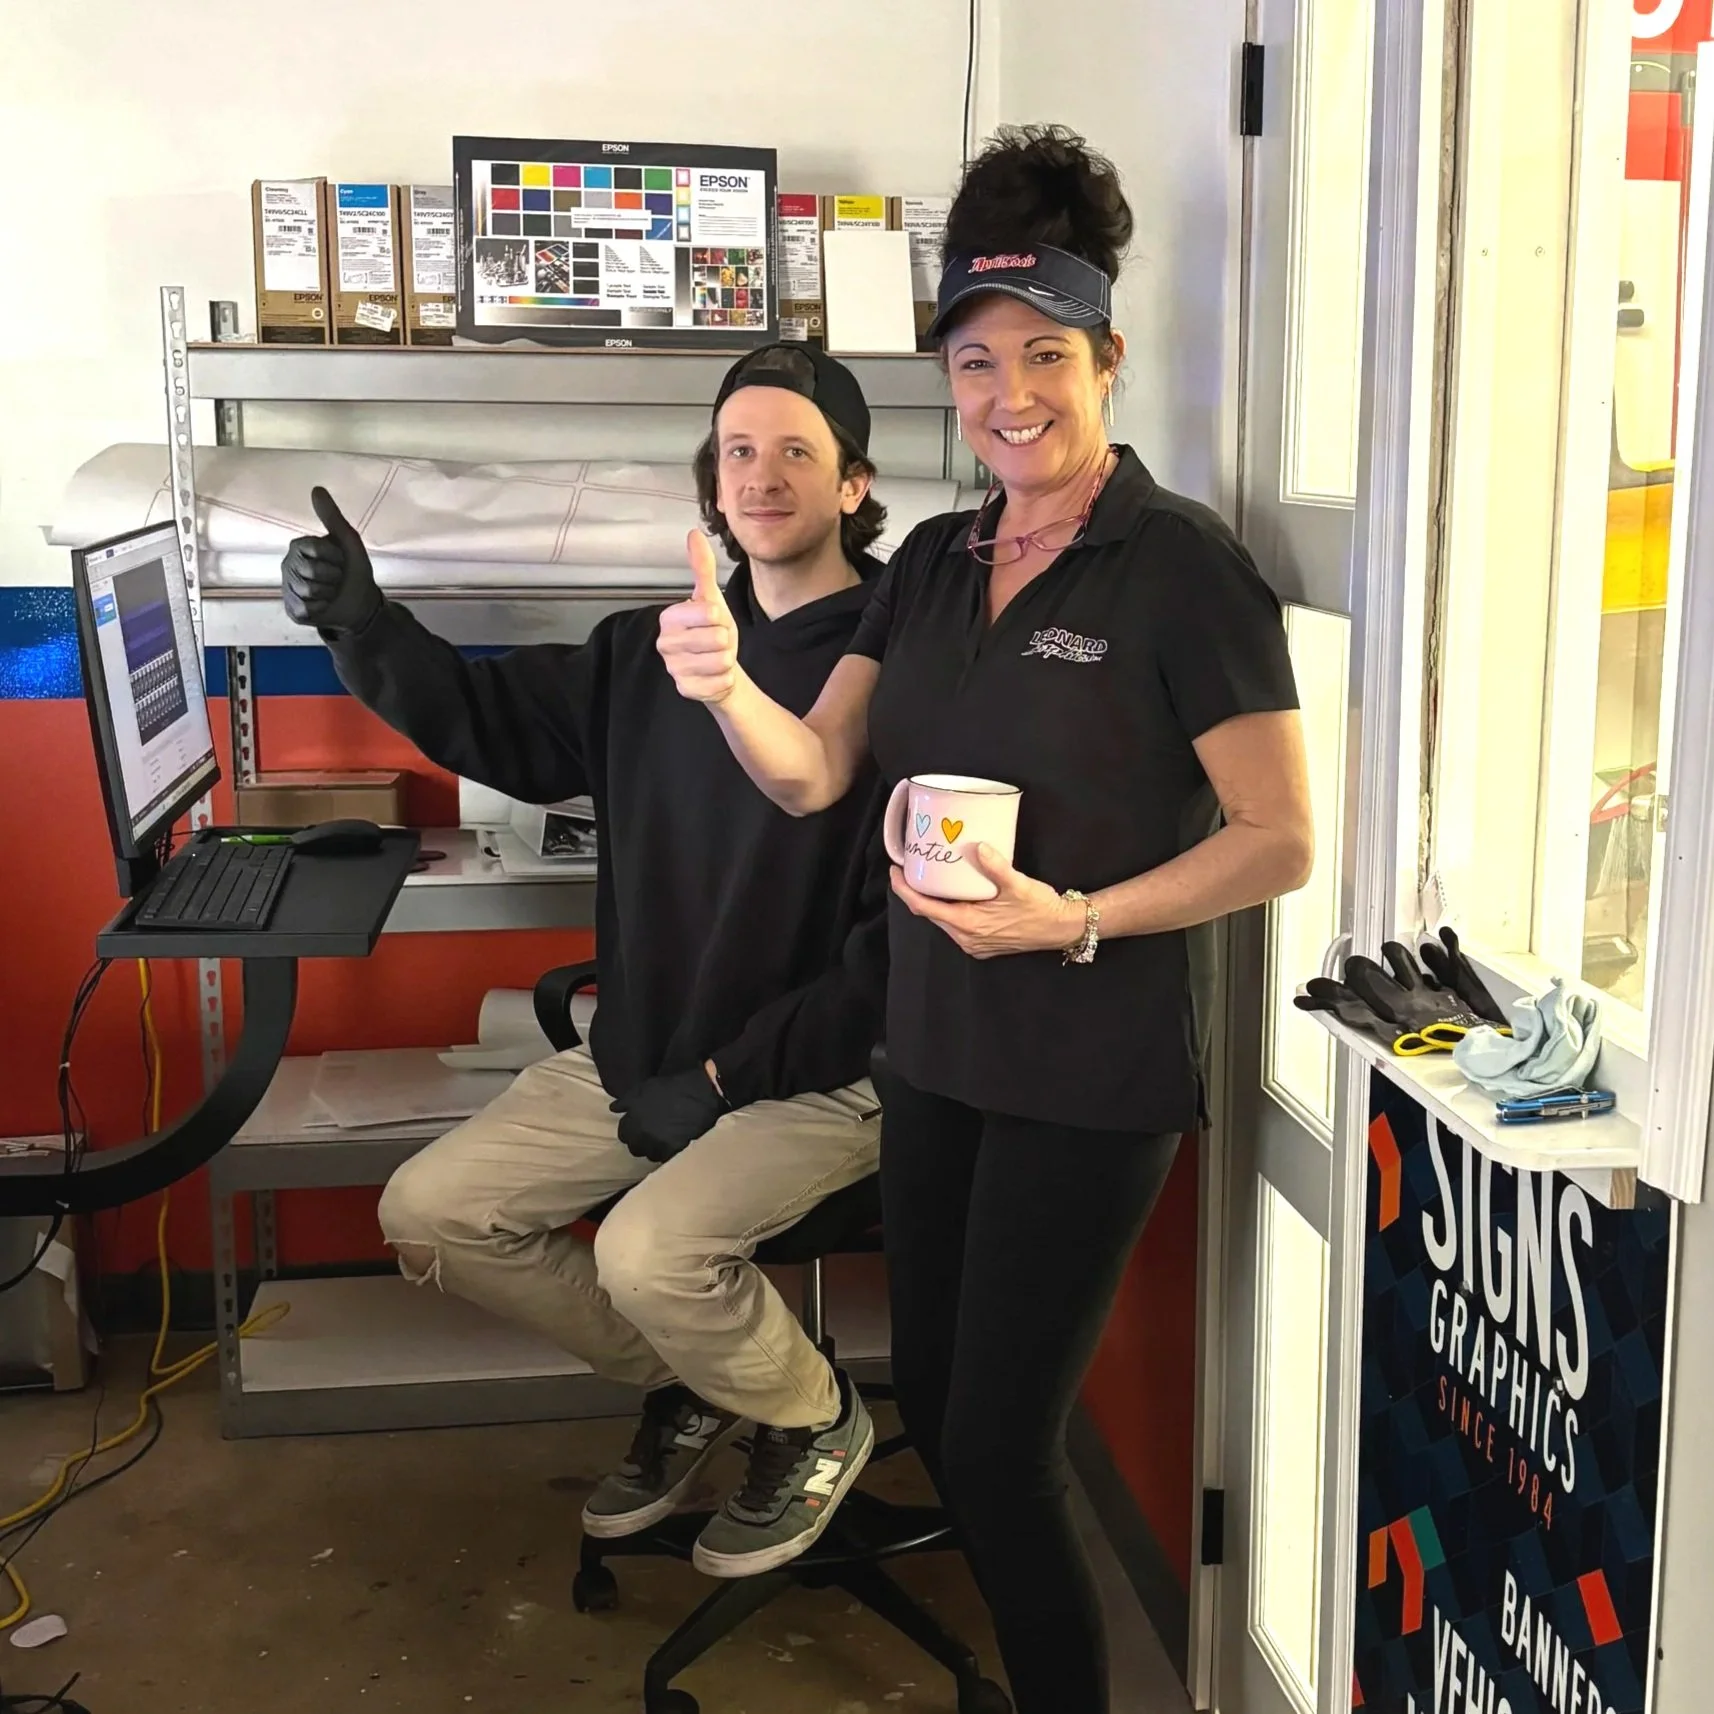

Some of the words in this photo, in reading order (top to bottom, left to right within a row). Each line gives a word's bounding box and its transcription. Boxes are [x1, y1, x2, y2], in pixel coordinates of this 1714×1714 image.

[602, 144, 630, 152] EPSON
[699, 175, 748, 188] EPSON
[605, 339, 632, 347] EPSON
[906, 842, 963, 863] untie
[1422, 1110, 1593, 1400] SIGNS
[1430, 1278, 1578, 1494] GRAPHICS
[1438, 1375, 1495, 1462] SINCE
[1508, 1446, 1553, 1530] 1984
[1501, 1569, 1618, 1714] BANNE
